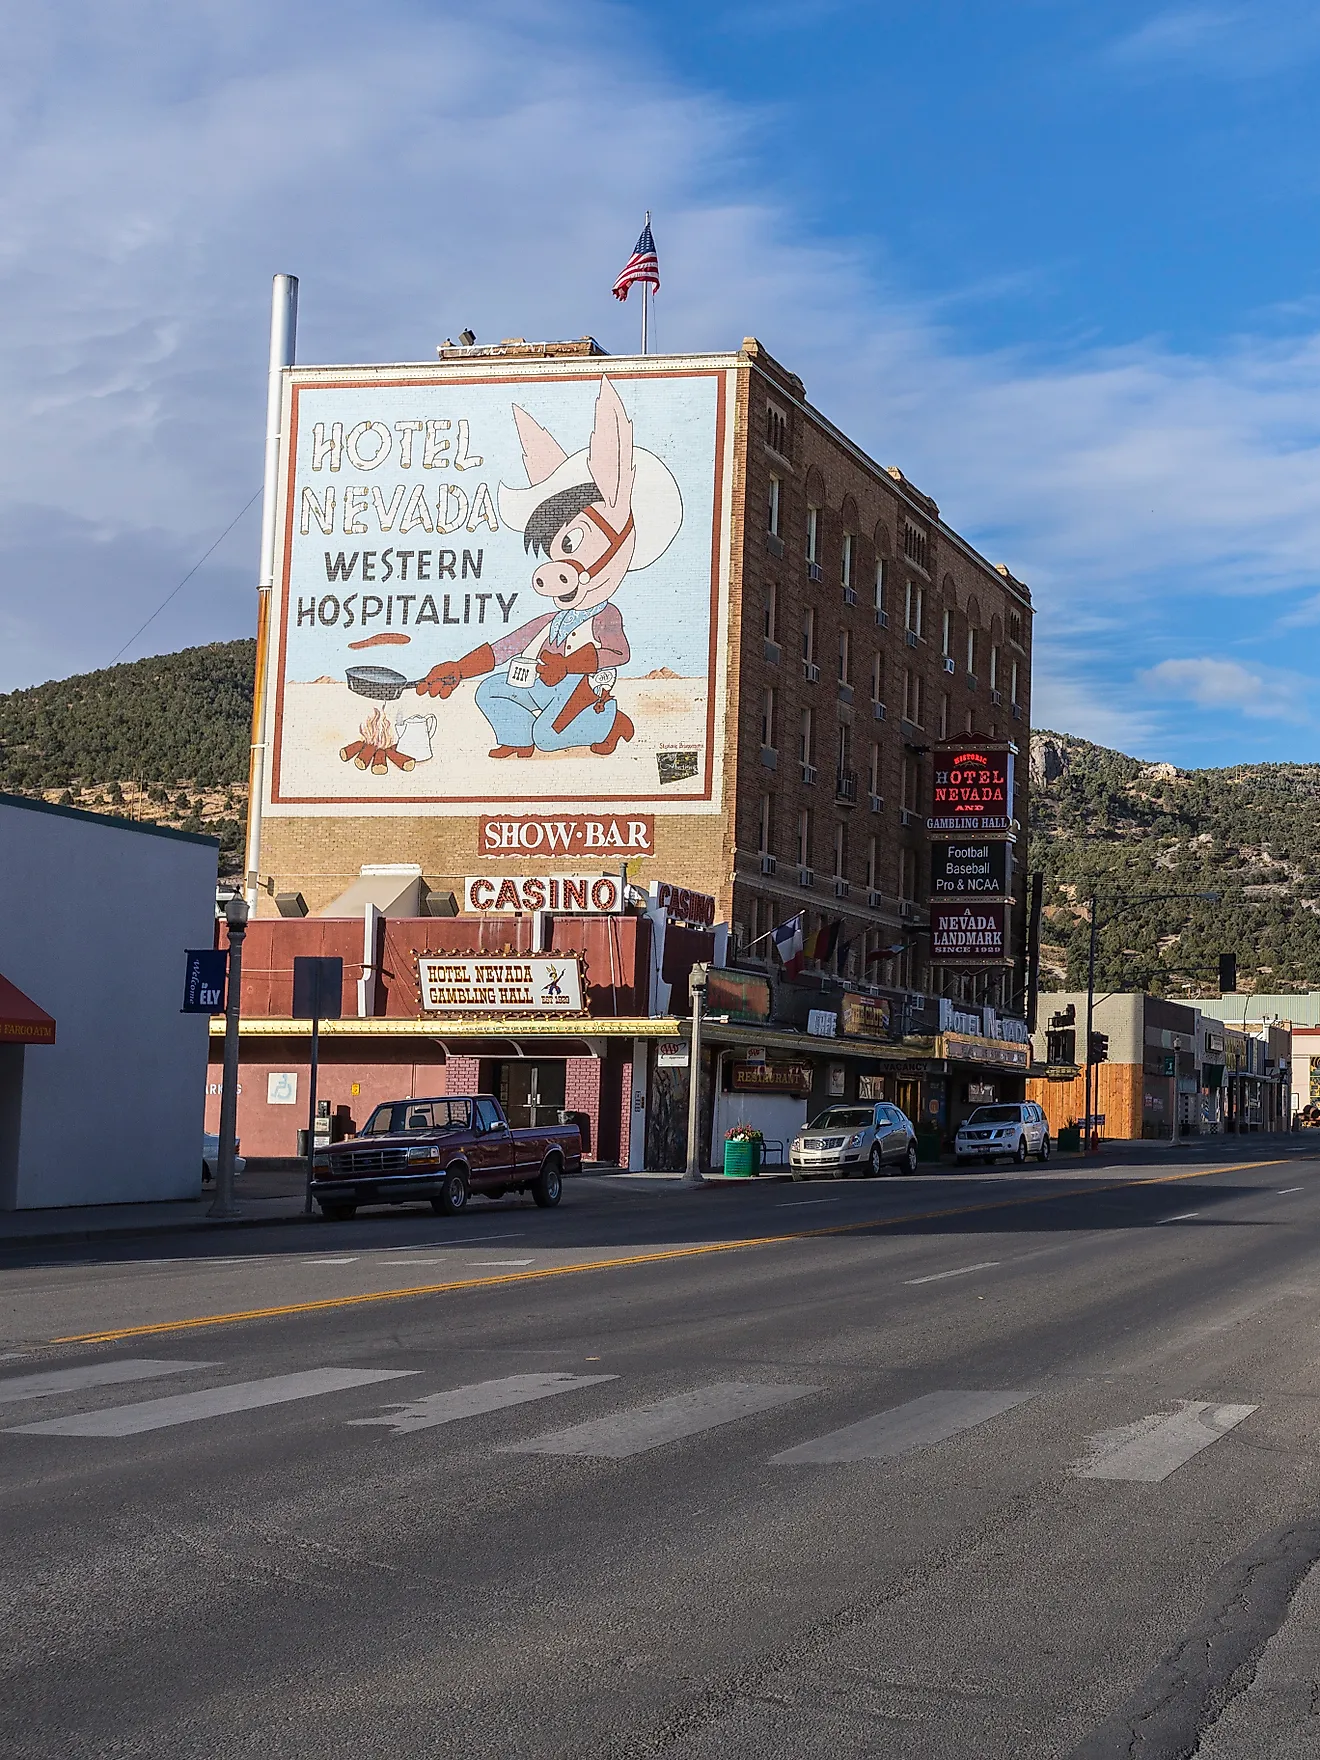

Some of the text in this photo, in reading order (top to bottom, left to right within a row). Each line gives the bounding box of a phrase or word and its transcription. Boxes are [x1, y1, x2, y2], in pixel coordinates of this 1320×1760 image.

[311, 419, 484, 472] HOTEL
[299, 482, 500, 535] NEVADA
[324, 546, 484, 583] WESTERN
[296, 592, 519, 628] HOSPITALITY
[511, 666, 530, 683] HN
[953, 753, 988, 765] HISTORIC
[935, 770, 1004, 785] HOTEL
[935, 787, 1004, 801] NEVADA
[926, 816, 1007, 829] GAMBLING HALL
[948, 846, 989, 859] Football
[946, 862, 990, 874] Baseball
[936, 879, 1000, 891] Pro & NCAA
[470, 878, 617, 911] CASINO
[658, 883, 716, 927] CASINO
[964, 908, 972, 916] A
[938, 917, 997, 931] NEVADA
[933, 931, 1003, 947] LANDMARK
[427, 965, 533, 983] HOTEL NEVADA
[190, 959, 200, 1005] Welcome
[200, 990, 220, 1005] ELY
[429, 987, 534, 1004] GAMBLING HALL
[940, 998, 1029, 1045] HOTEL NEVADA
[4, 1024, 33, 1036] FARGO
[883, 1061, 928, 1072] VACANCY
[737, 1071, 800, 1084] RESTAURANT
